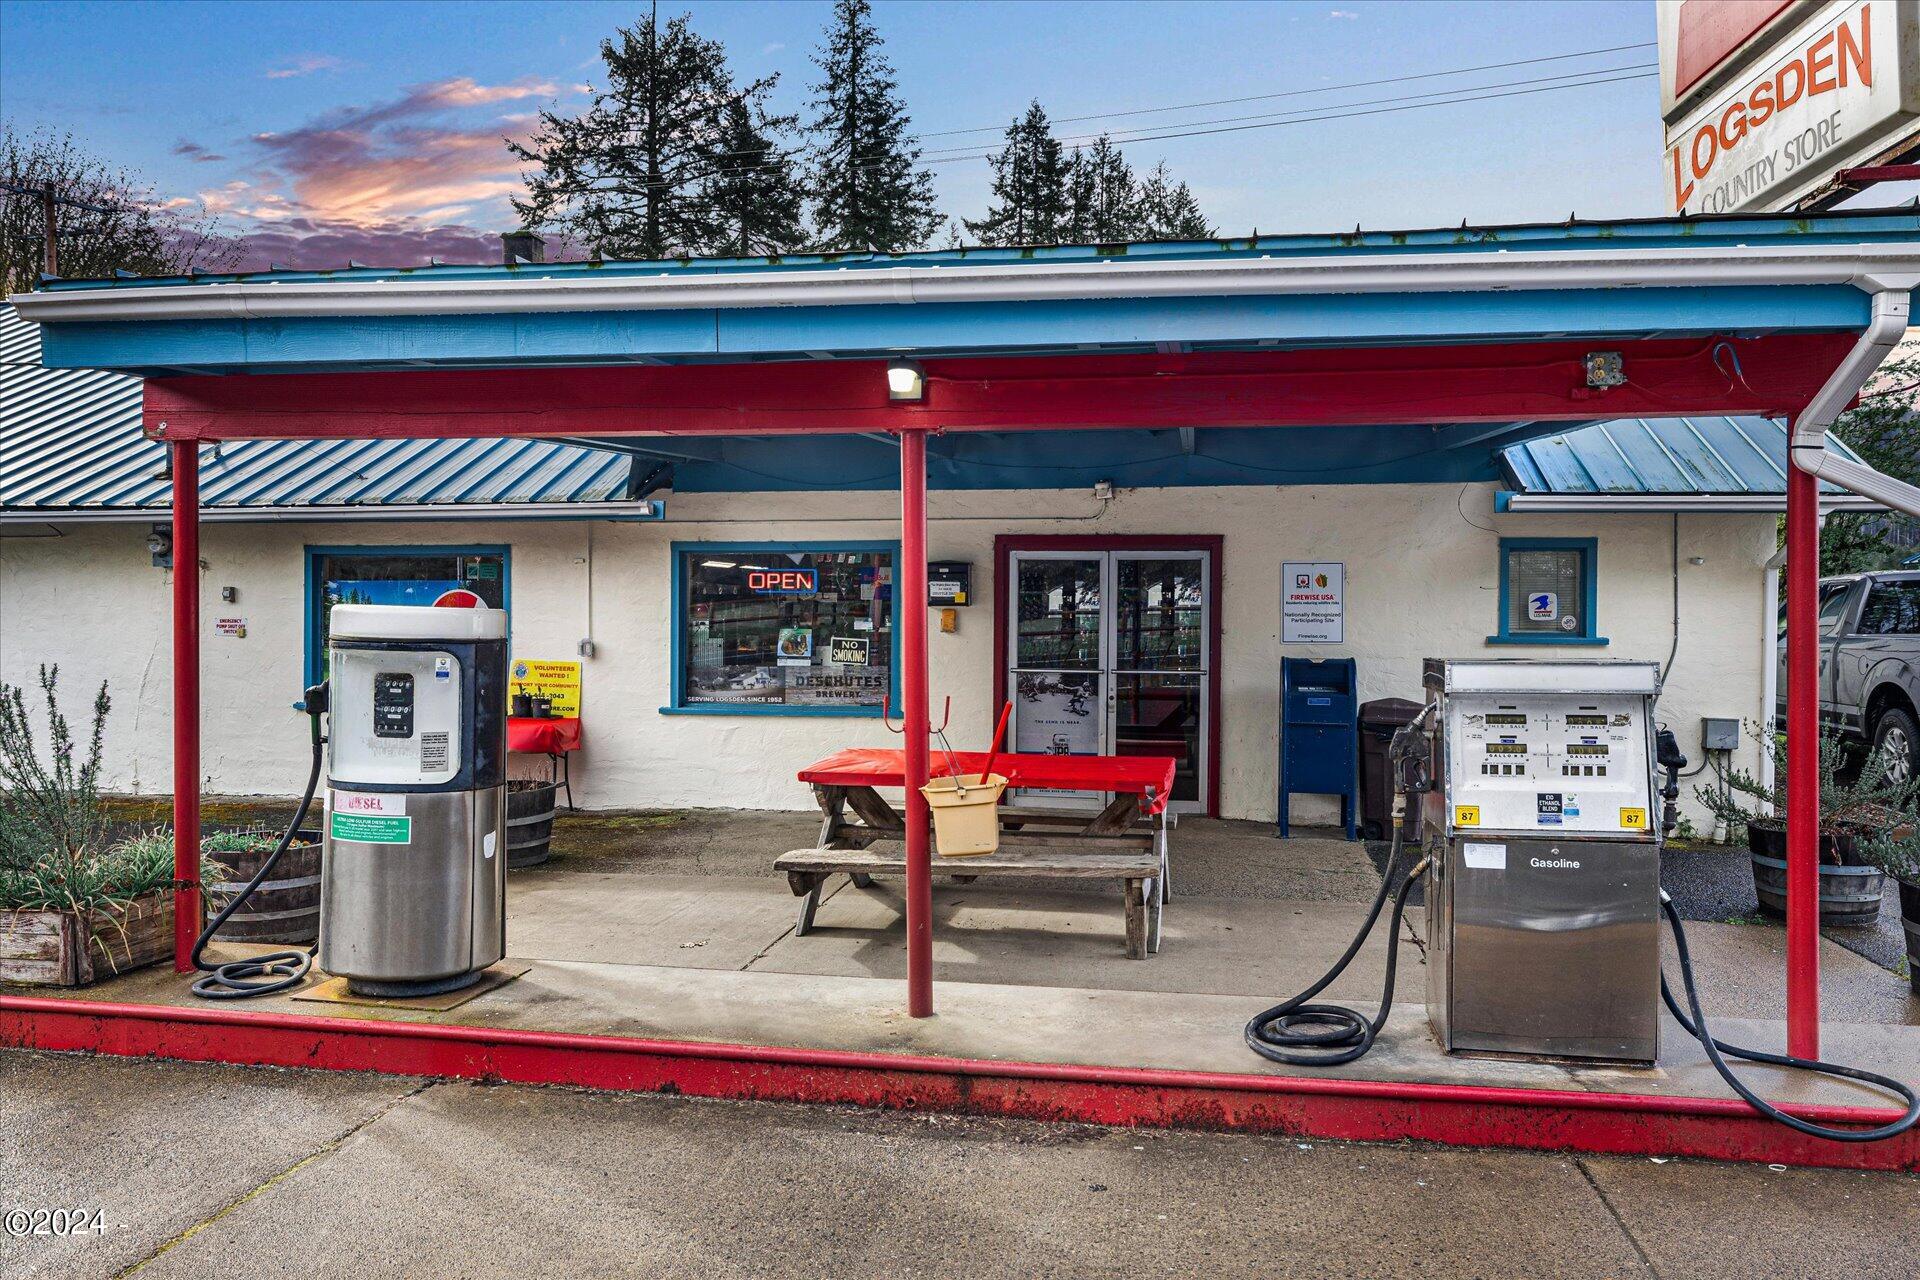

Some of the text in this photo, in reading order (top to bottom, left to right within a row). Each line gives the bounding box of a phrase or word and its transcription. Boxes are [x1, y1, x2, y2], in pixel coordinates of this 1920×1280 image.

[1673, 3, 1872, 212] LOGSDEN
[1701, 110, 1842, 213] COUNTRY STORE
[748, 573, 813, 589] OPEN
[841, 641, 859, 650] NO
[832, 649, 866, 663] SMOKING
[795, 674, 882, 687] DESCHUTES
[347, 797, 383, 810] DIESEL
[1461, 812, 1474, 821] 87
[1626, 814, 1639, 823] 87
[1530, 857, 1580, 869] Gasoline
